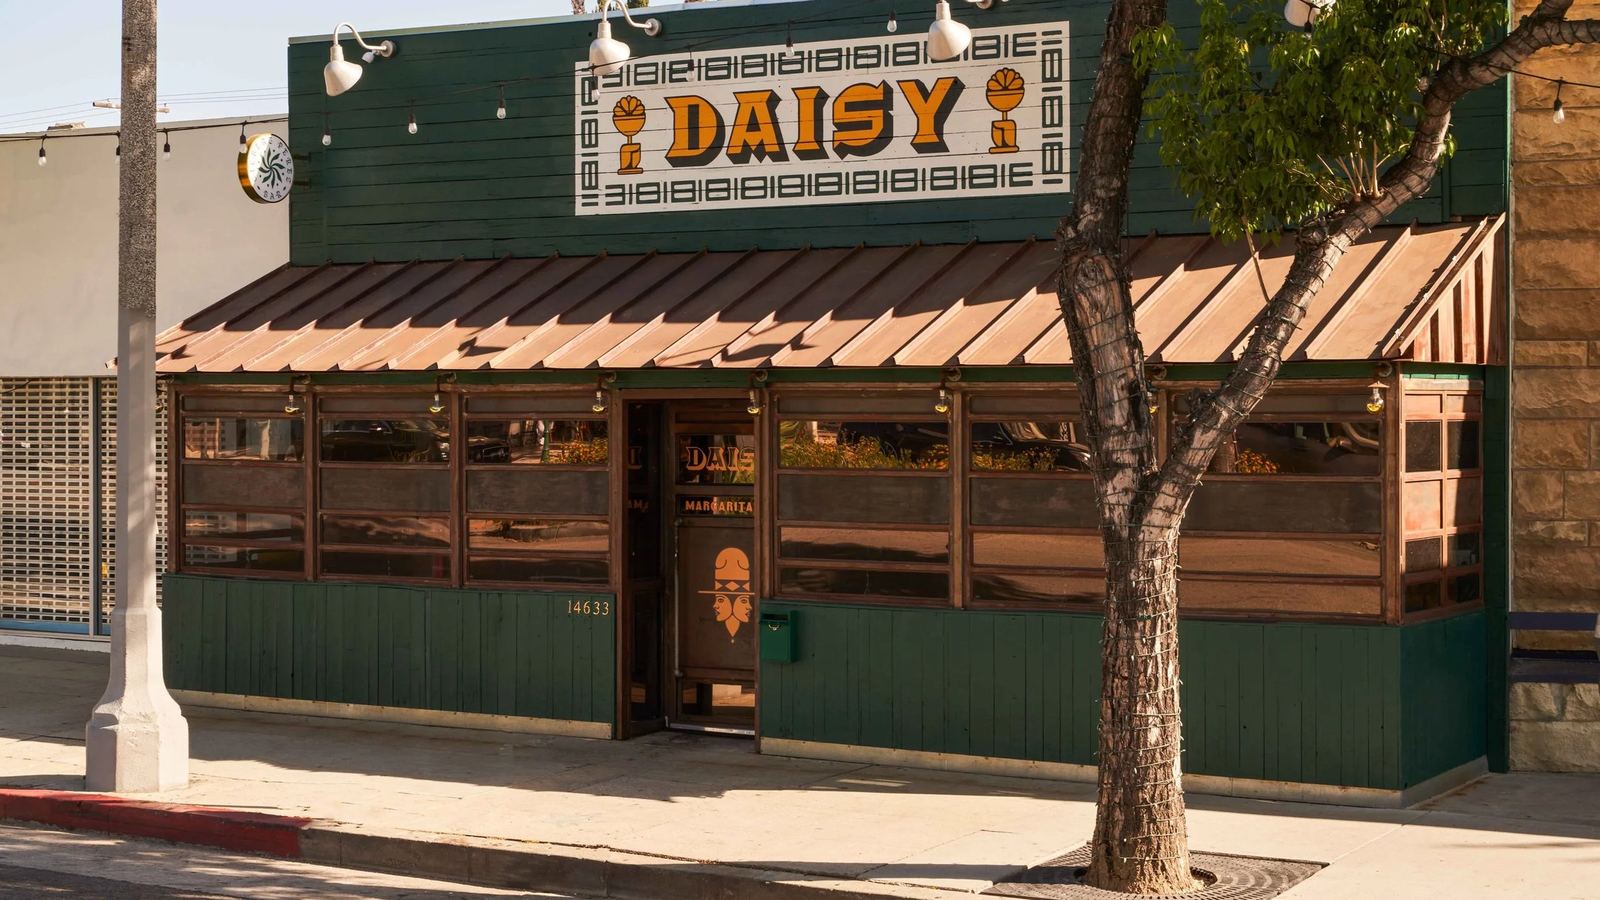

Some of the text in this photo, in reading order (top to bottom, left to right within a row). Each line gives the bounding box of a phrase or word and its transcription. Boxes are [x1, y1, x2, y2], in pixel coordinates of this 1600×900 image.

[664, 76, 966, 168] DAISY
[685, 501, 753, 513] MARGARITA
[567, 600, 609, 616] 14633
